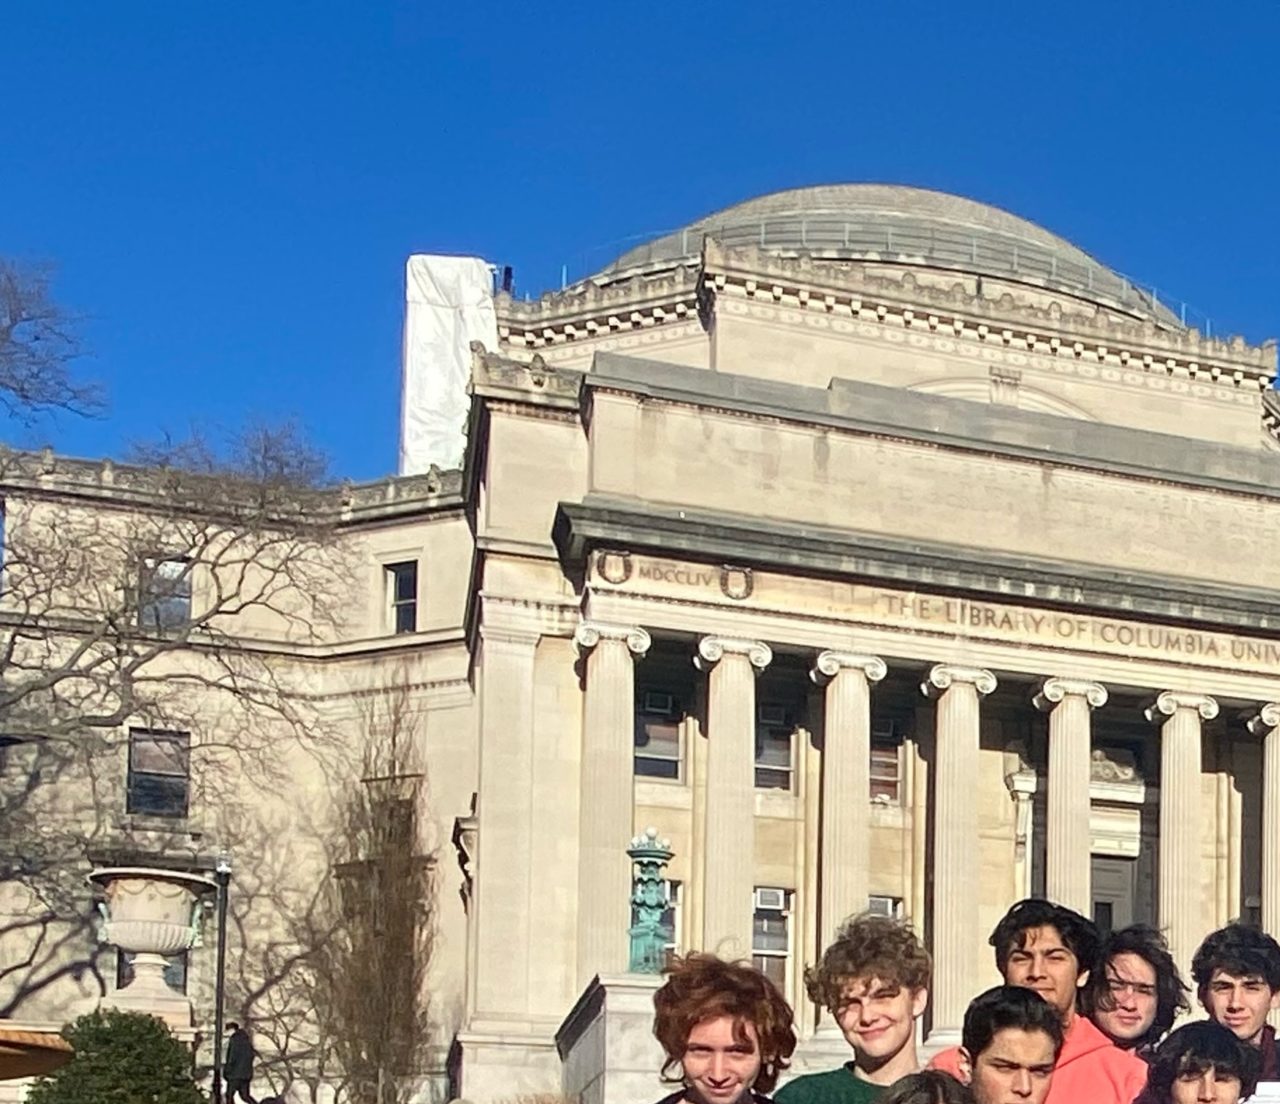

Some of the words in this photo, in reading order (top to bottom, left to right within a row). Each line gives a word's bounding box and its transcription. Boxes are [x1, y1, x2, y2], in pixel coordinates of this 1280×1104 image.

[639, 566, 712, 586] MDCCLIV
[883, 594, 930, 619] THE
[946, 599, 1046, 634] LIBRARY
[1056, 617, 1089, 638] OF
[1100, 624, 1219, 657] COLUMBIA
